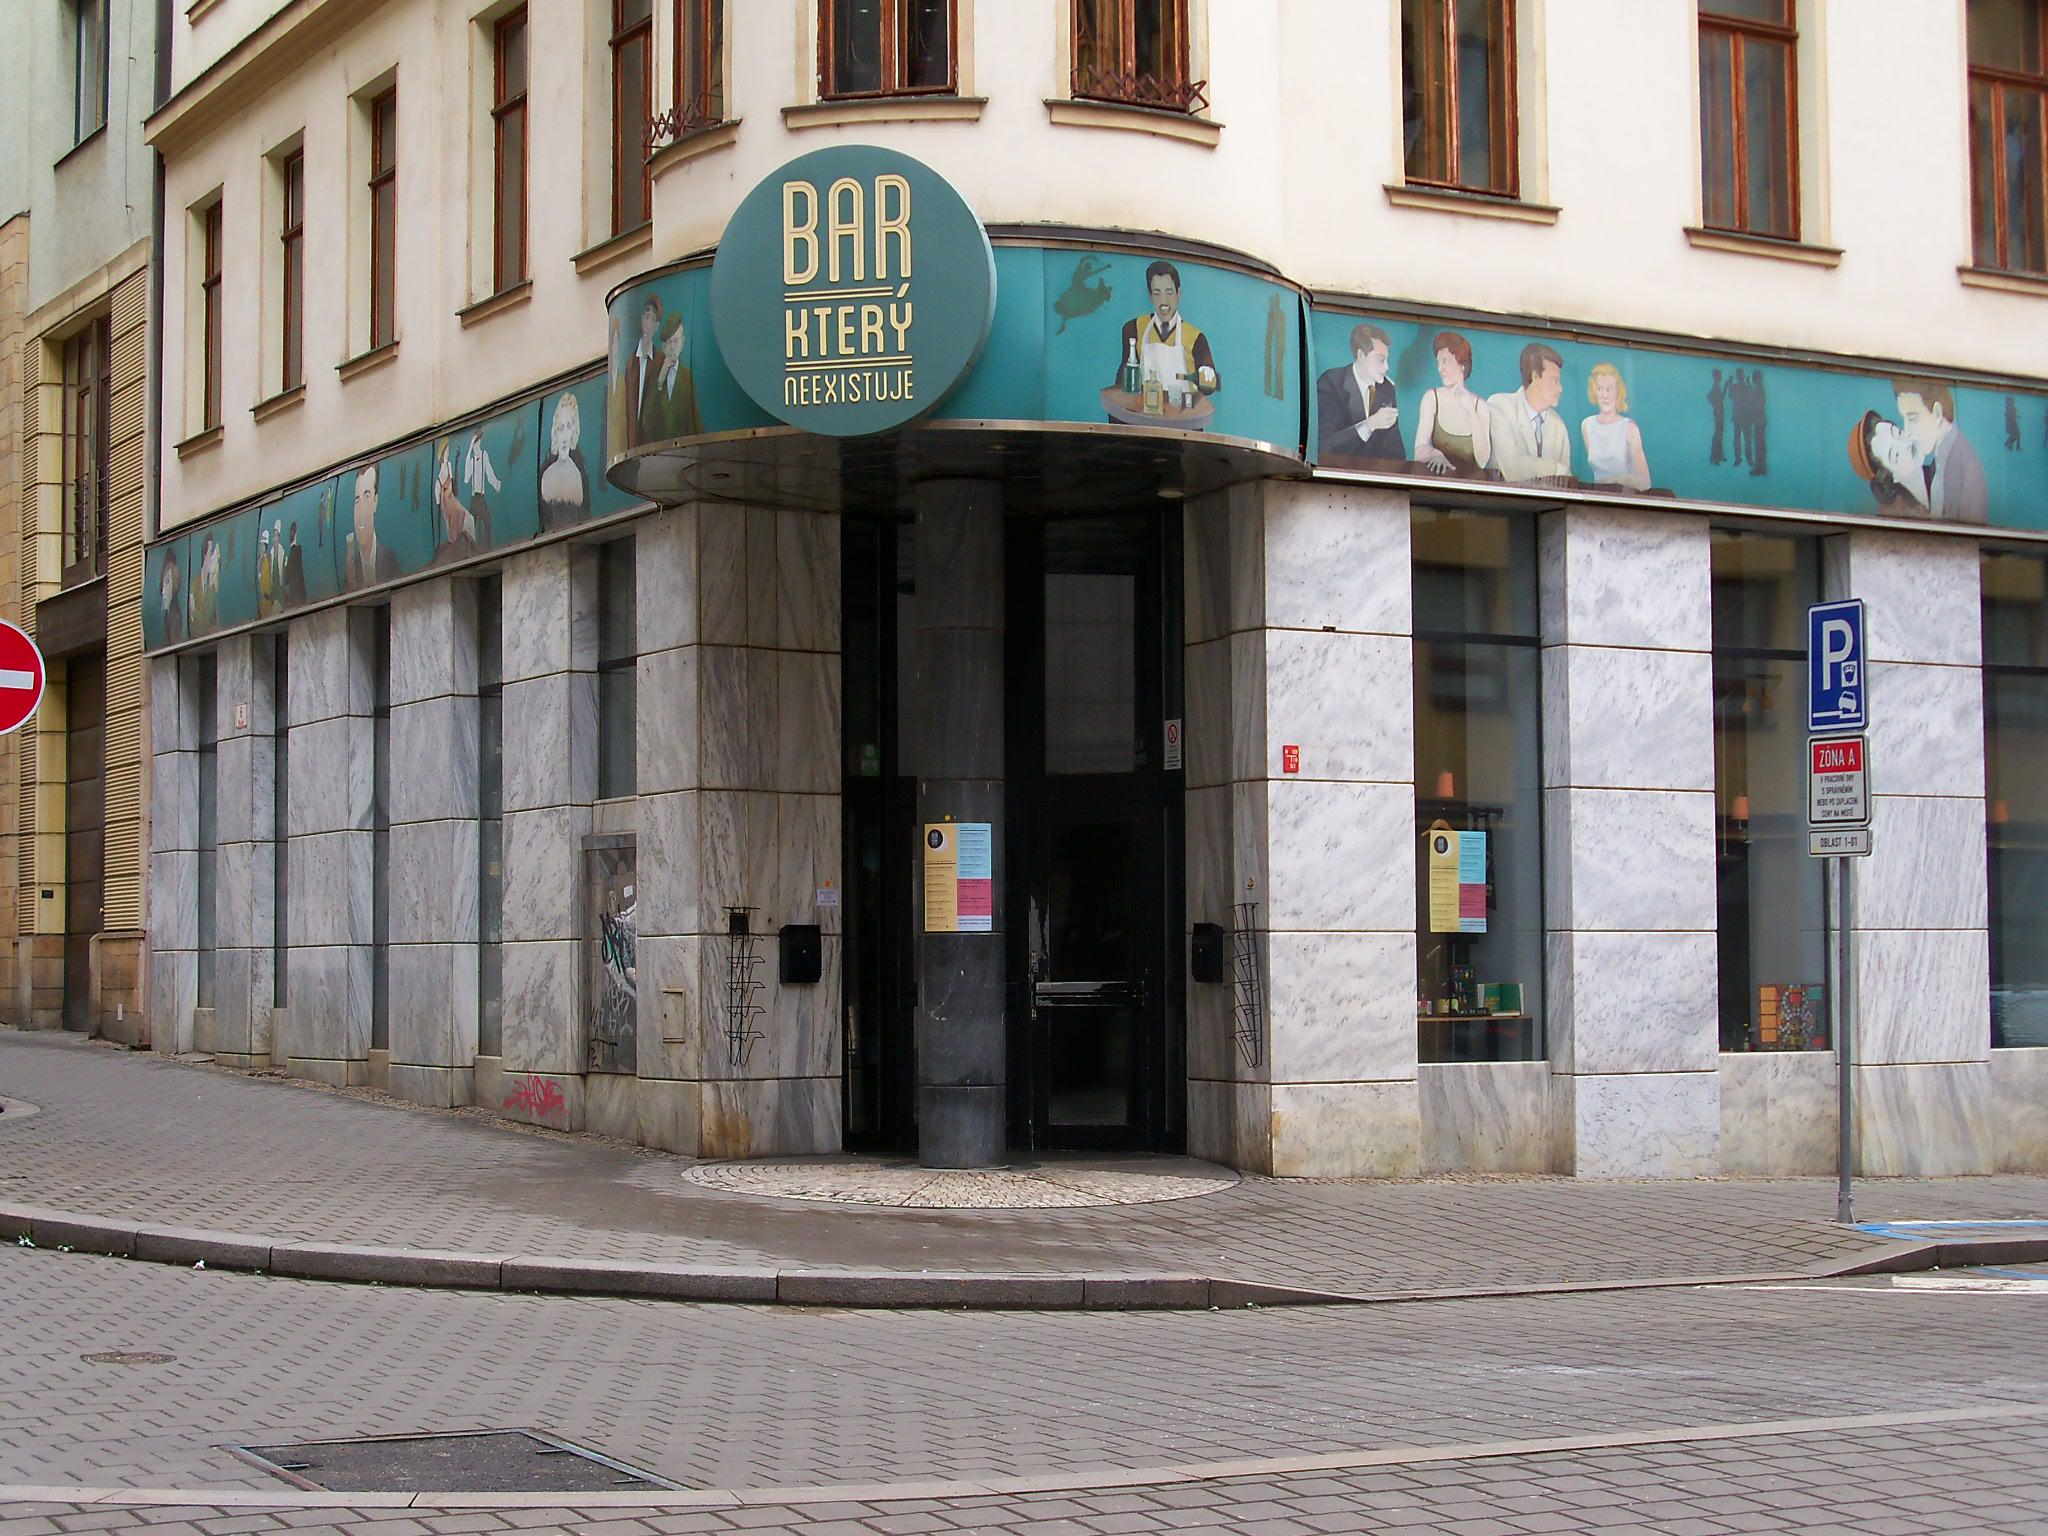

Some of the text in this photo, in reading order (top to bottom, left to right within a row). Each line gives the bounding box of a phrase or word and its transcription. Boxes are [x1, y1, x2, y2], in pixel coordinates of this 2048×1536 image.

[783, 174, 911, 285] BAR
[785, 283, 912, 358] KTERÝ
[784, 370, 913, 406] NEEXISTUJE
[1822, 619, 1853, 690] P
[1819, 745, 1856, 767] ZÓNA A
[1820, 837, 1842, 848] OBLAST
